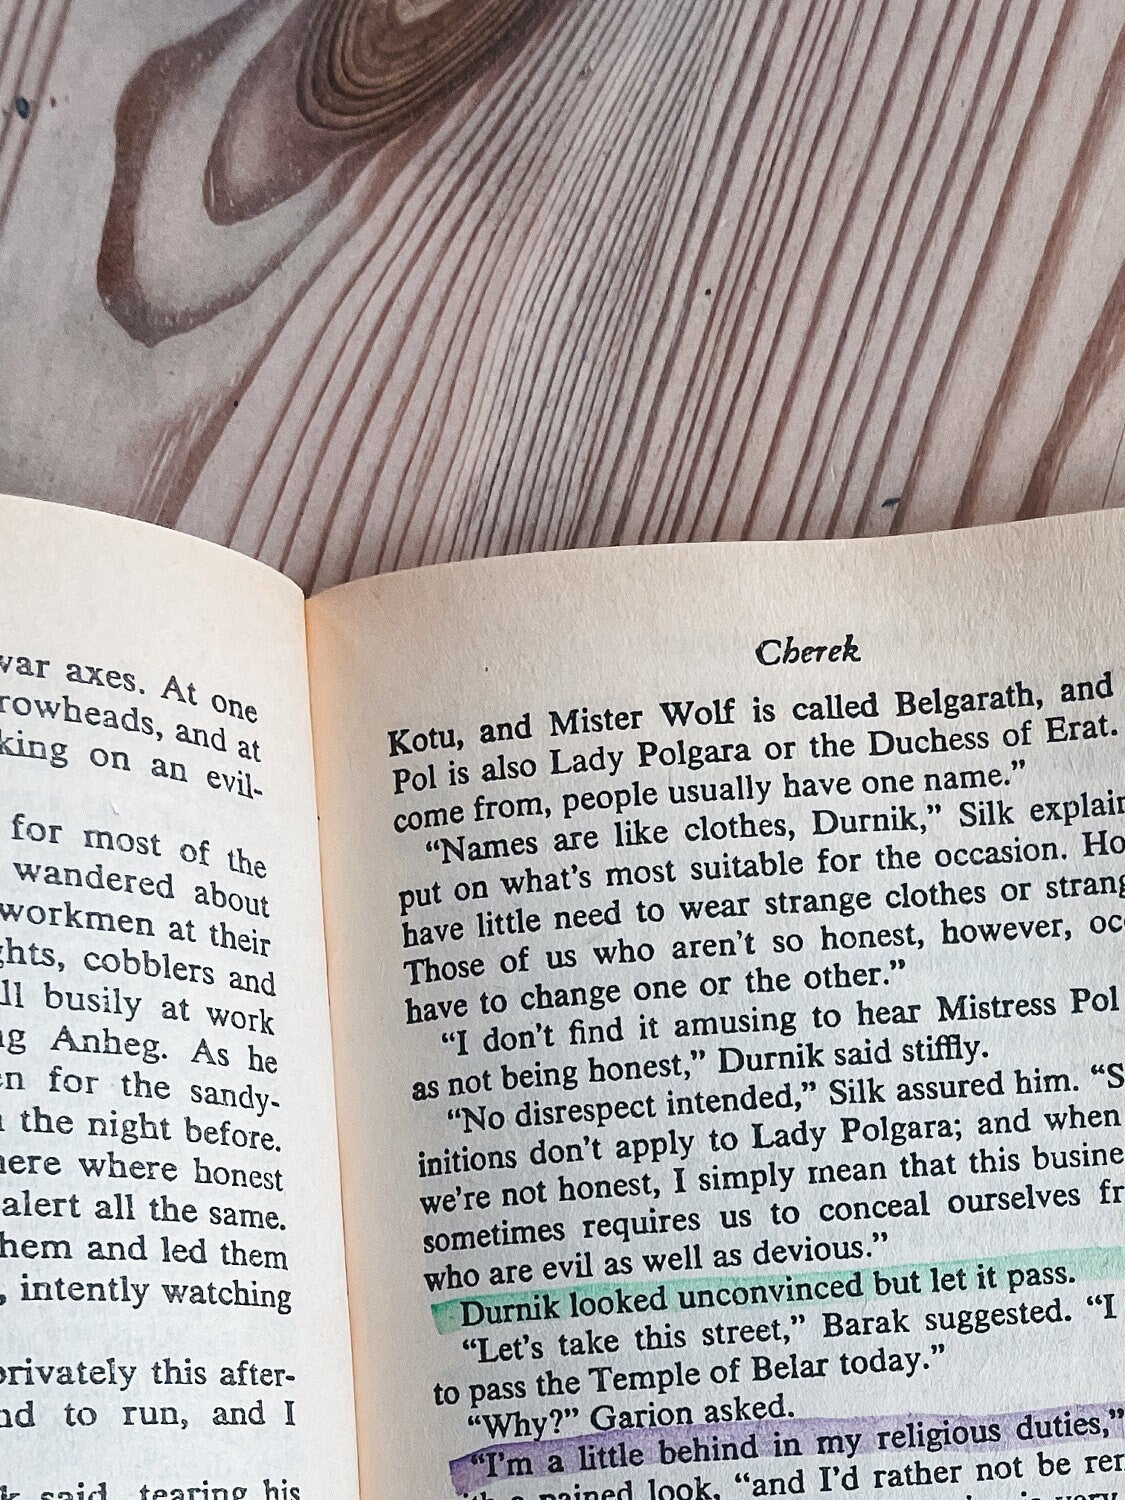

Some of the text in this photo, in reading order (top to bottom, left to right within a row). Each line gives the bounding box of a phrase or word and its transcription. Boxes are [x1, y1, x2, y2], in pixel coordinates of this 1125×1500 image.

[754, 633, 862, 667] Cherek
[65, 663, 258, 724] axes. At one
[387, 727, 464, 758] Kotu,
[479, 712, 533, 744] and
[547, 706, 644, 737] Mister
[658, 696, 736, 727] Wolf
[752, 696, 776, 724] is
[792, 691, 880, 721] called
[894, 680, 1044, 720] Belgarath,
[1060, 670, 1114, 703] and
[393, 758, 1026, 834] come from, people usually have one name.”
[11, 812, 267, 879] for most of the
[401, 921, 464, 949] have
[475, 907, 542, 938] little
[553, 898, 623, 930] need
[635, 900, 665, 923] to
[678, 896, 751, 921] wear
[764, 891, 872, 918] strange
[885, 879, 987, 909] clothes
[1000, 881, 1032, 902] or
[83, 947, 277, 997] cobblers and
[19, 1105, 281, 1153] the night before.
[447, 1105, 505, 1134] “No
[514, 1094, 657, 1128] disrespect
[666, 1080, 817, 1117] intended,”
[828, 1076, 887, 1106] Silk
[896, 1069, 1006, 1102] assured
[1013, 1067, 1079, 1095] him.
[1, 1189, 286, 1231] alert all the same.
[20, 1272, 292, 1315] intently watching
[459, 1263, 1076, 1328] Durnik looked unconvinced but let it pass.
[432, 1343, 945, 1410] to pass the Temple of Belar today.”
